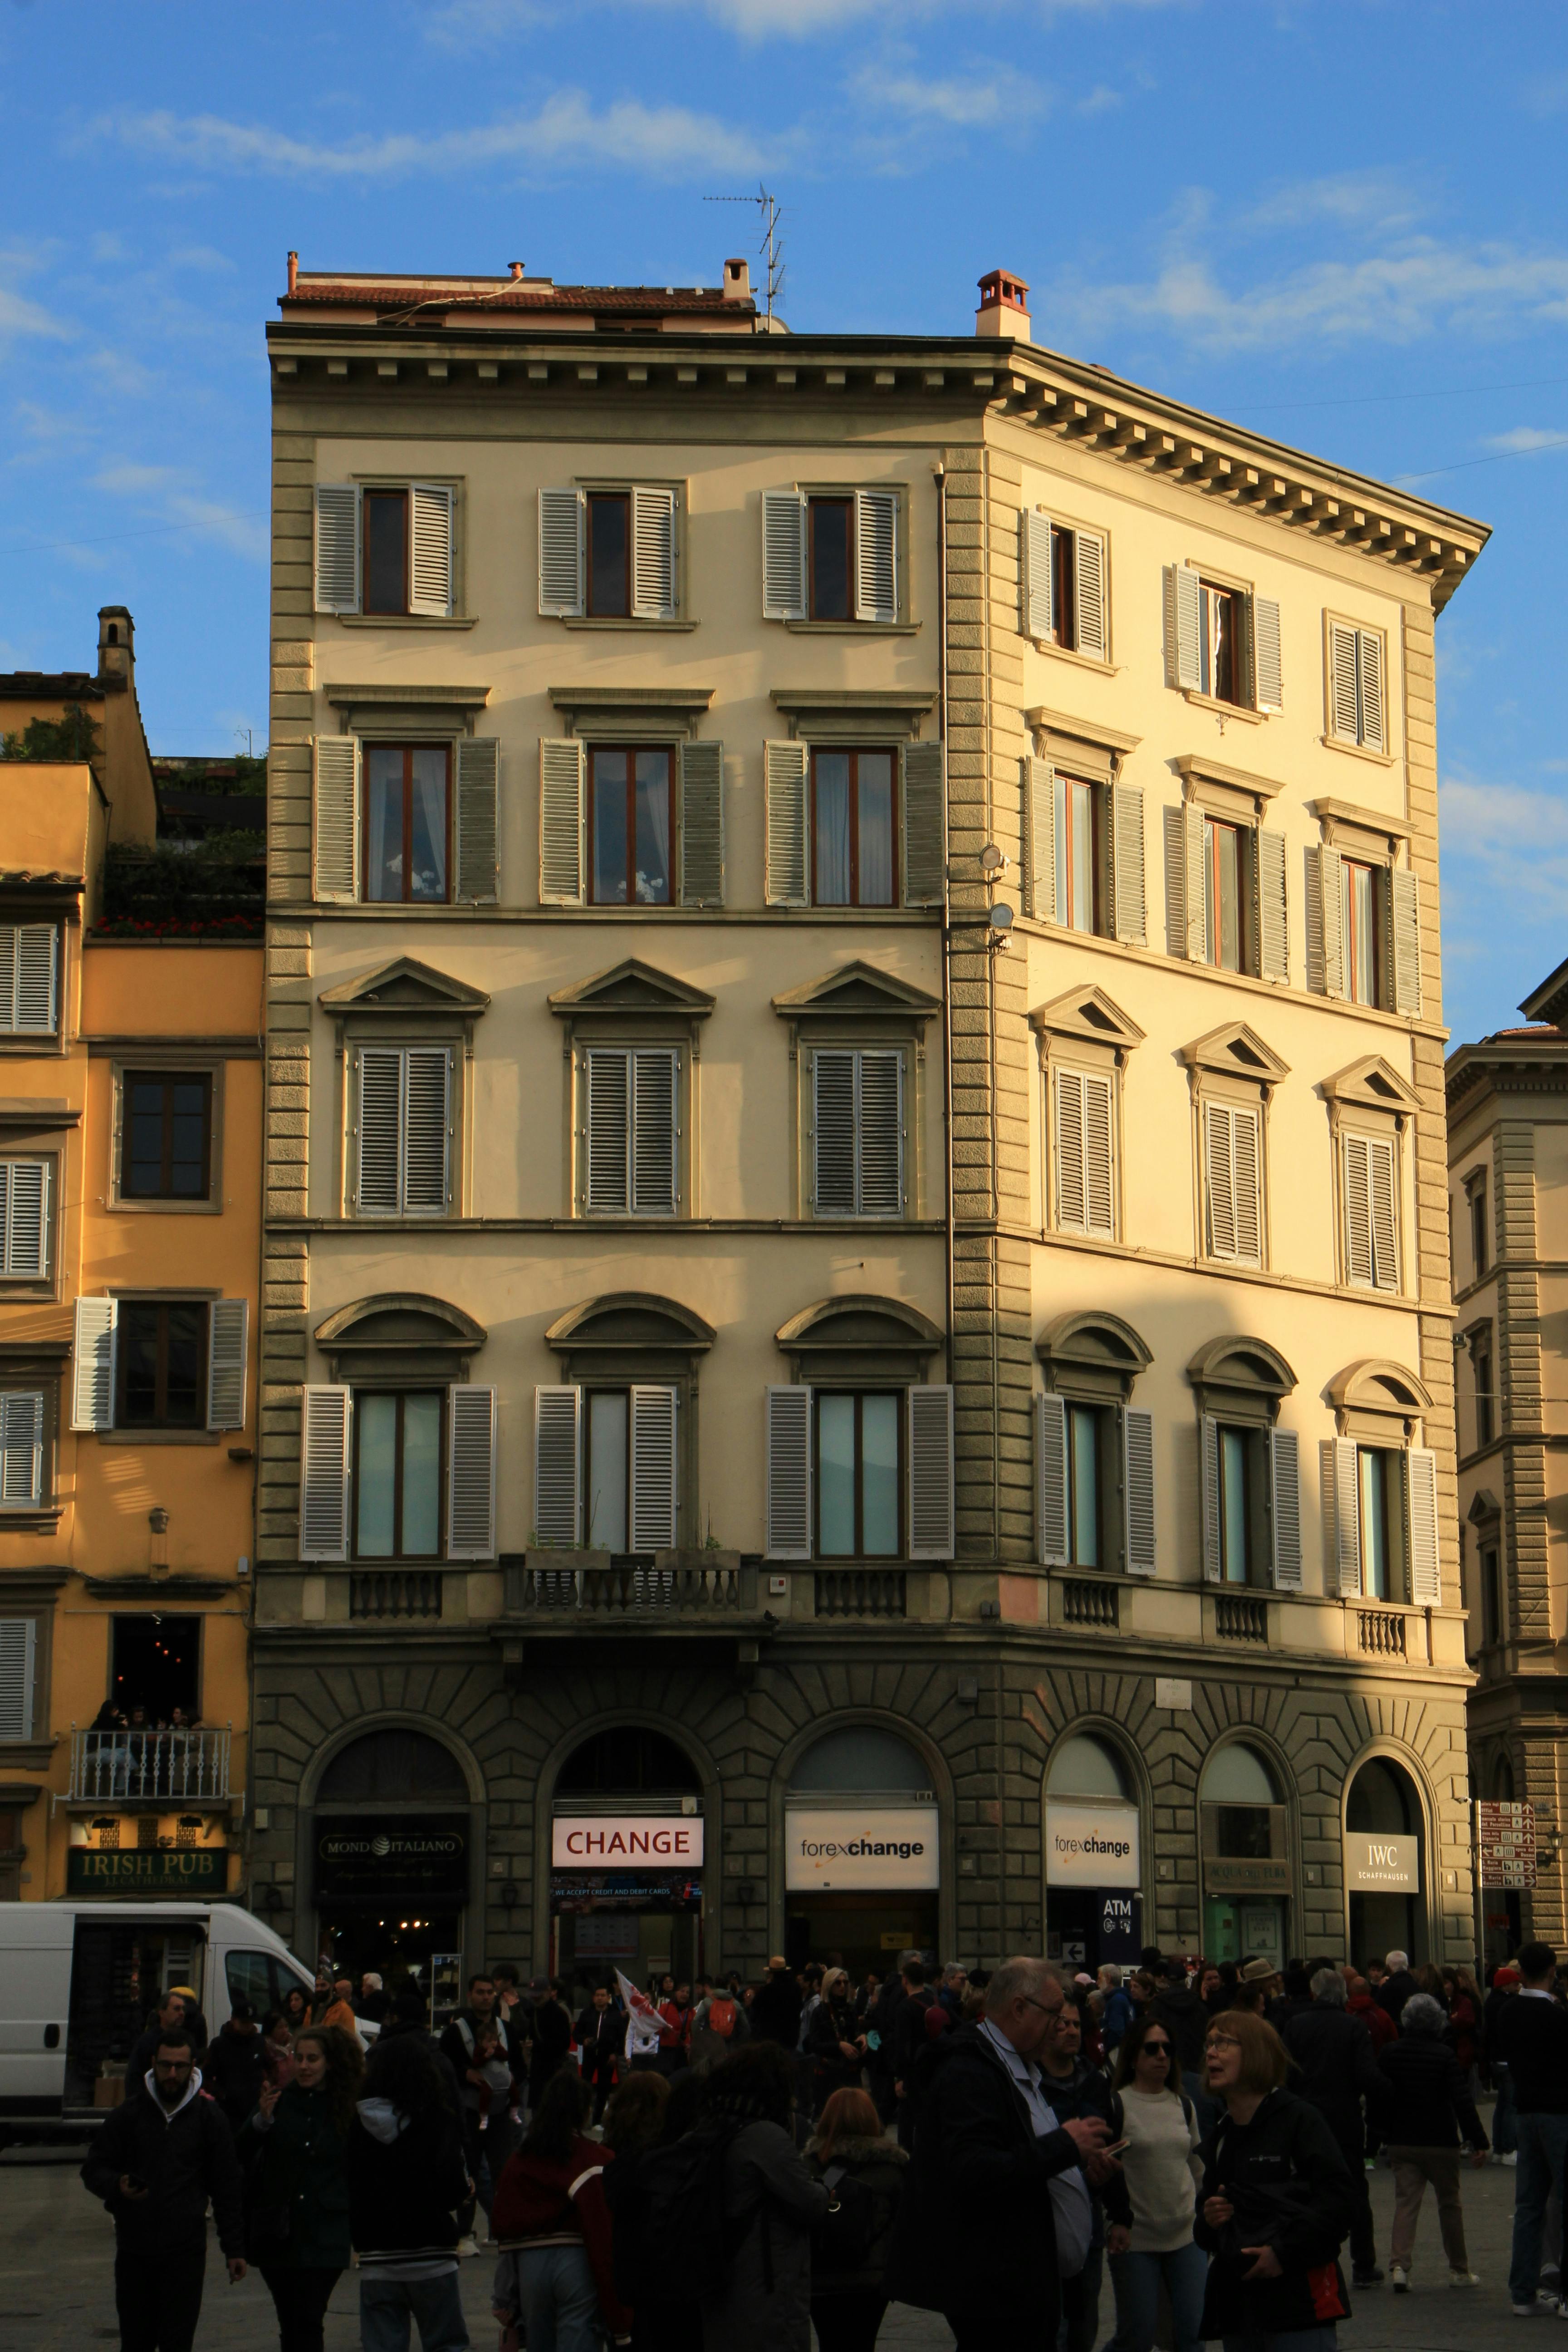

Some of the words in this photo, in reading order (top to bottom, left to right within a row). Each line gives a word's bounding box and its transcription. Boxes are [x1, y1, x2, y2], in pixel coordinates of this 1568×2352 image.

[391, 1841, 455, 1852] ITALIANO
[567, 1831, 690, 1854] CHANGE
[801, 1839, 924, 1859] forexchange
[1055, 1835, 1130, 1857] forexchange
[83, 1855, 153, 1876] IRISH
[163, 1854, 213, 1874] PUB
[1368, 1845, 1397, 1867] IWC
[1358, 1872, 1408, 1881] SCHAFFHAUSEN
[1104, 1900, 1131, 1916] ATM
